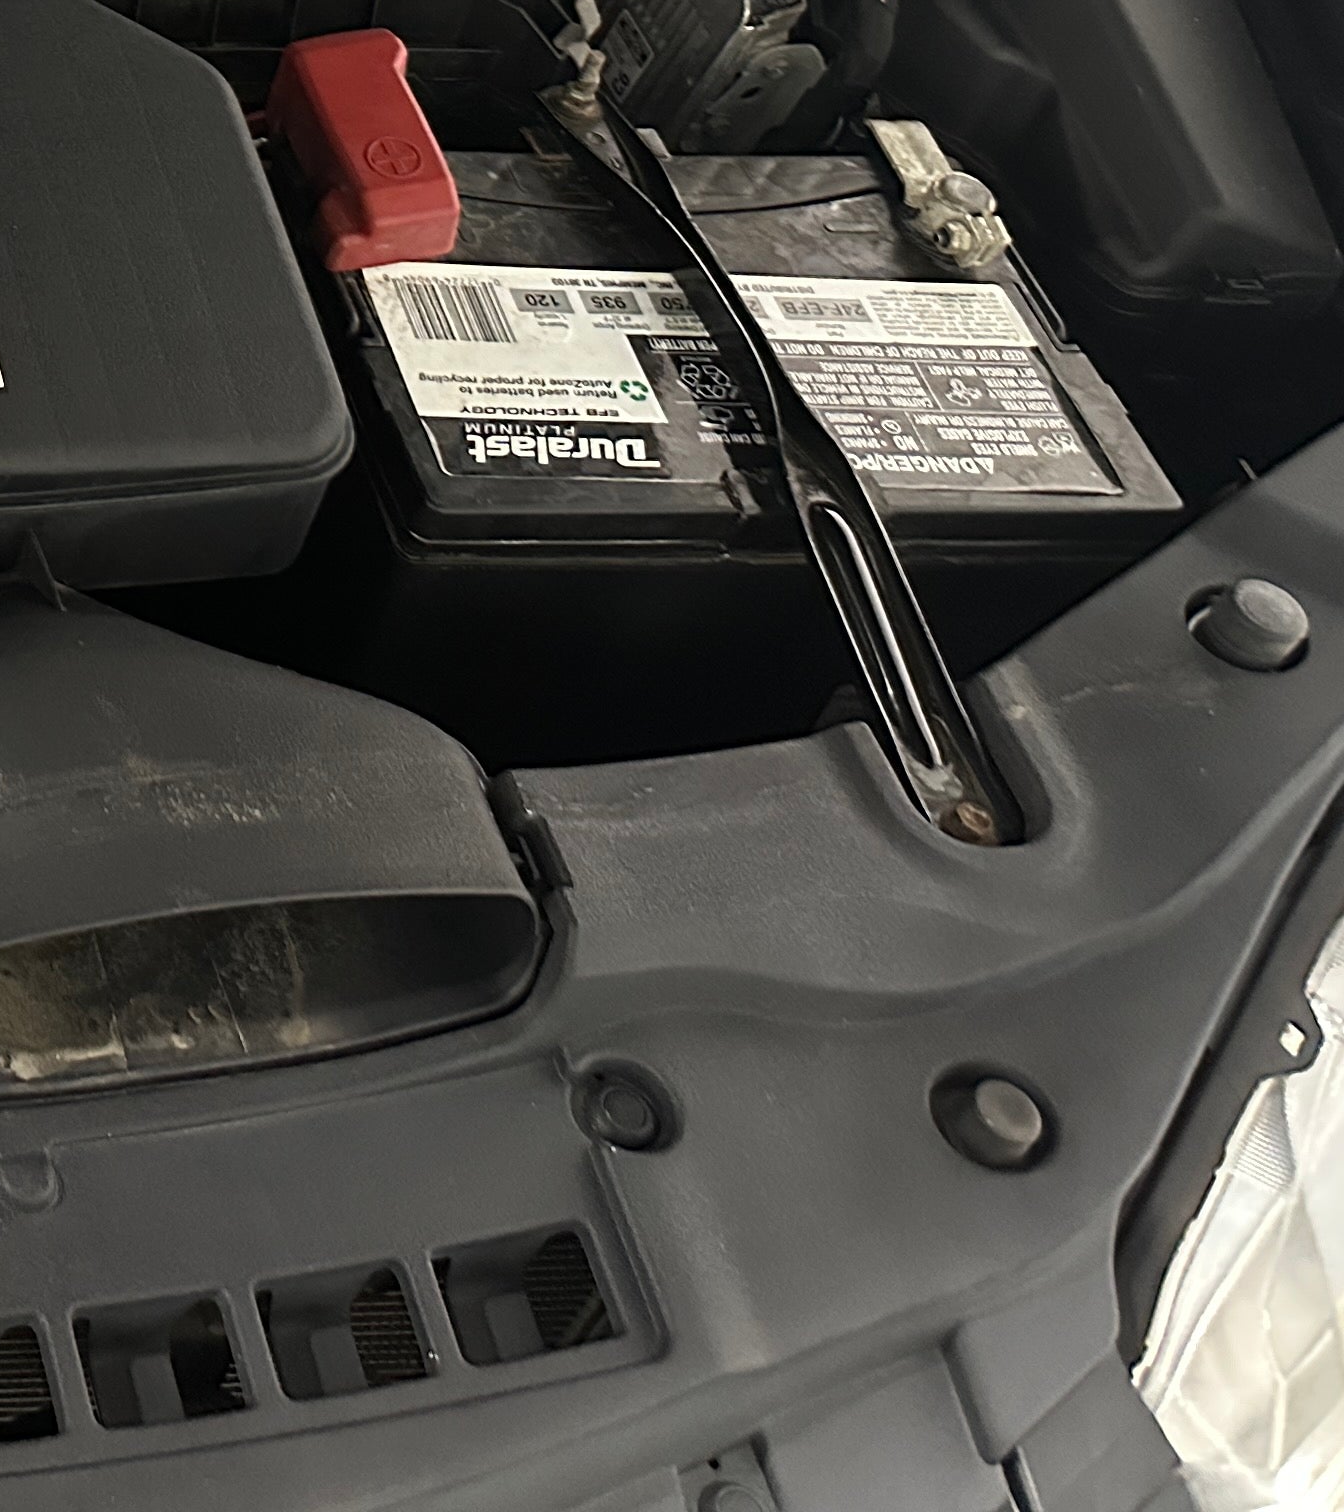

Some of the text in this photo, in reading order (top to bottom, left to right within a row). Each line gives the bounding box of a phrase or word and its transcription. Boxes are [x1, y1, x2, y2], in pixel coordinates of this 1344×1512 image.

[524, 292, 561, 307] 120
[590, 295, 627, 310] 935
[662, 296, 691, 311] 50
[783, 300, 866, 317] 24F-EFB
[783, 343, 808, 355] NOT
[807, 344, 825, 355] DO
[829, 344, 885, 357] CHILDREN
[884, 346, 901, 357] OF
[899, 346, 937, 359] REACH
[936, 348, 962, 360] THE
[962, 349, 977, 360] OF
[976, 349, 1001, 361] OUT
[1002, 349, 1029, 361] KEEP
[418, 373, 613, 389] AutoZone for proper recycling
[458, 385, 618, 400] Return used batteries to
[461, 406, 620, 417] EFB TECHNOLOGY
[464, 421, 576, 437] PLATINUM
[893, 436, 919, 451] NO
[466, 434, 661, 468] Duralast
